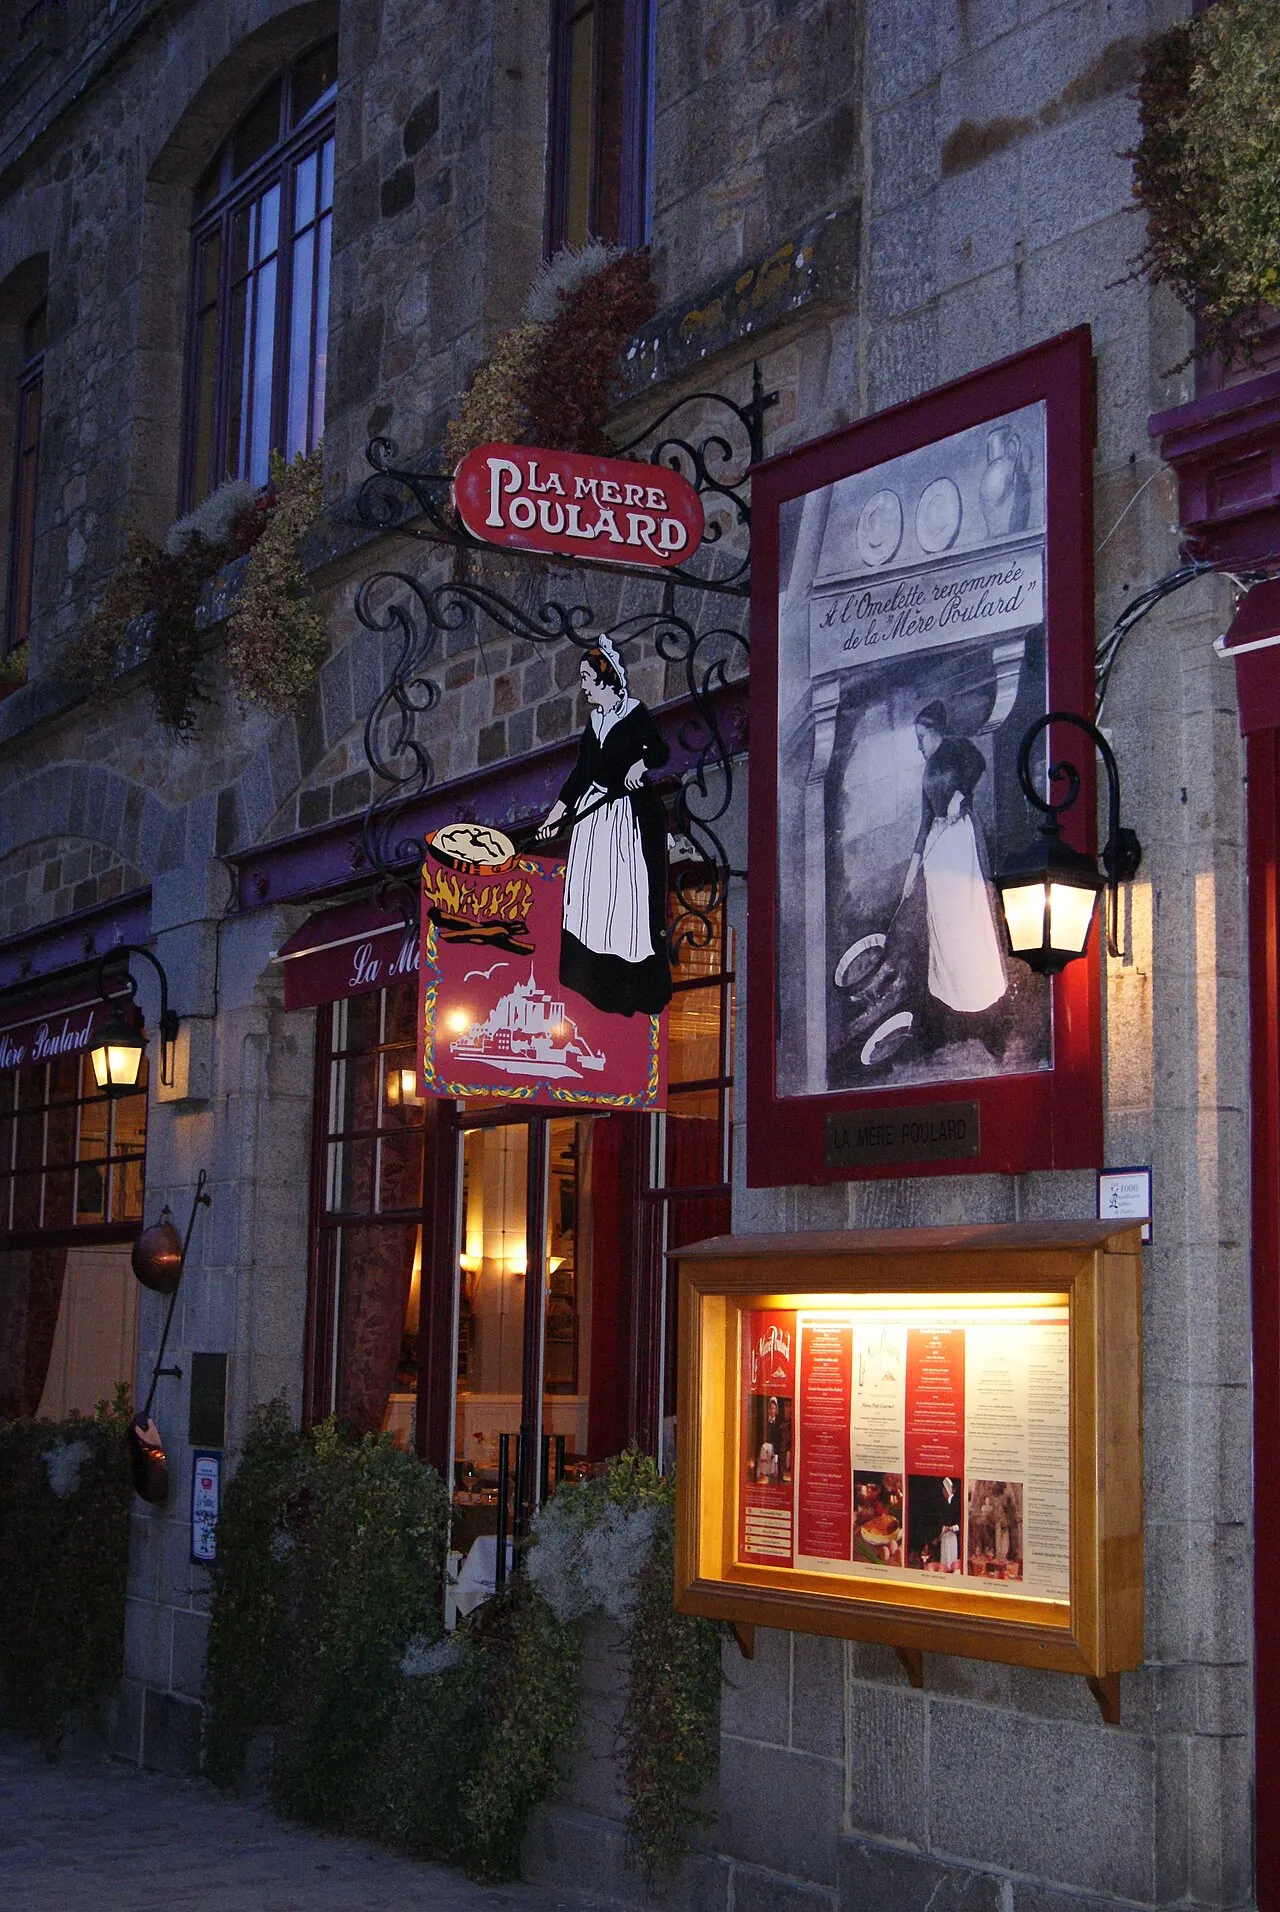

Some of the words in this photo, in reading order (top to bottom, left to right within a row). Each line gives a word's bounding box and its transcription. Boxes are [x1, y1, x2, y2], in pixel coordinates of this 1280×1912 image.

[485, 458, 687, 558] POULARD
[527, 461, 566, 496] LA
[574, 476, 668, 510] MERE
[840, 582, 925, 623] l'Omelette
[932, 561, 1024, 601] renommée
[843, 628, 862, 650] de
[864, 620, 881, 645] la
[349, 943, 382, 986] La
[32, 1011, 94, 1060] Poulard
[834, 1129, 850, 1149] LA
[858, 1125, 893, 1147] MERE
[902, 1119, 967, 1143] POULARD
[1120, 1184, 1139, 1193] 1000
